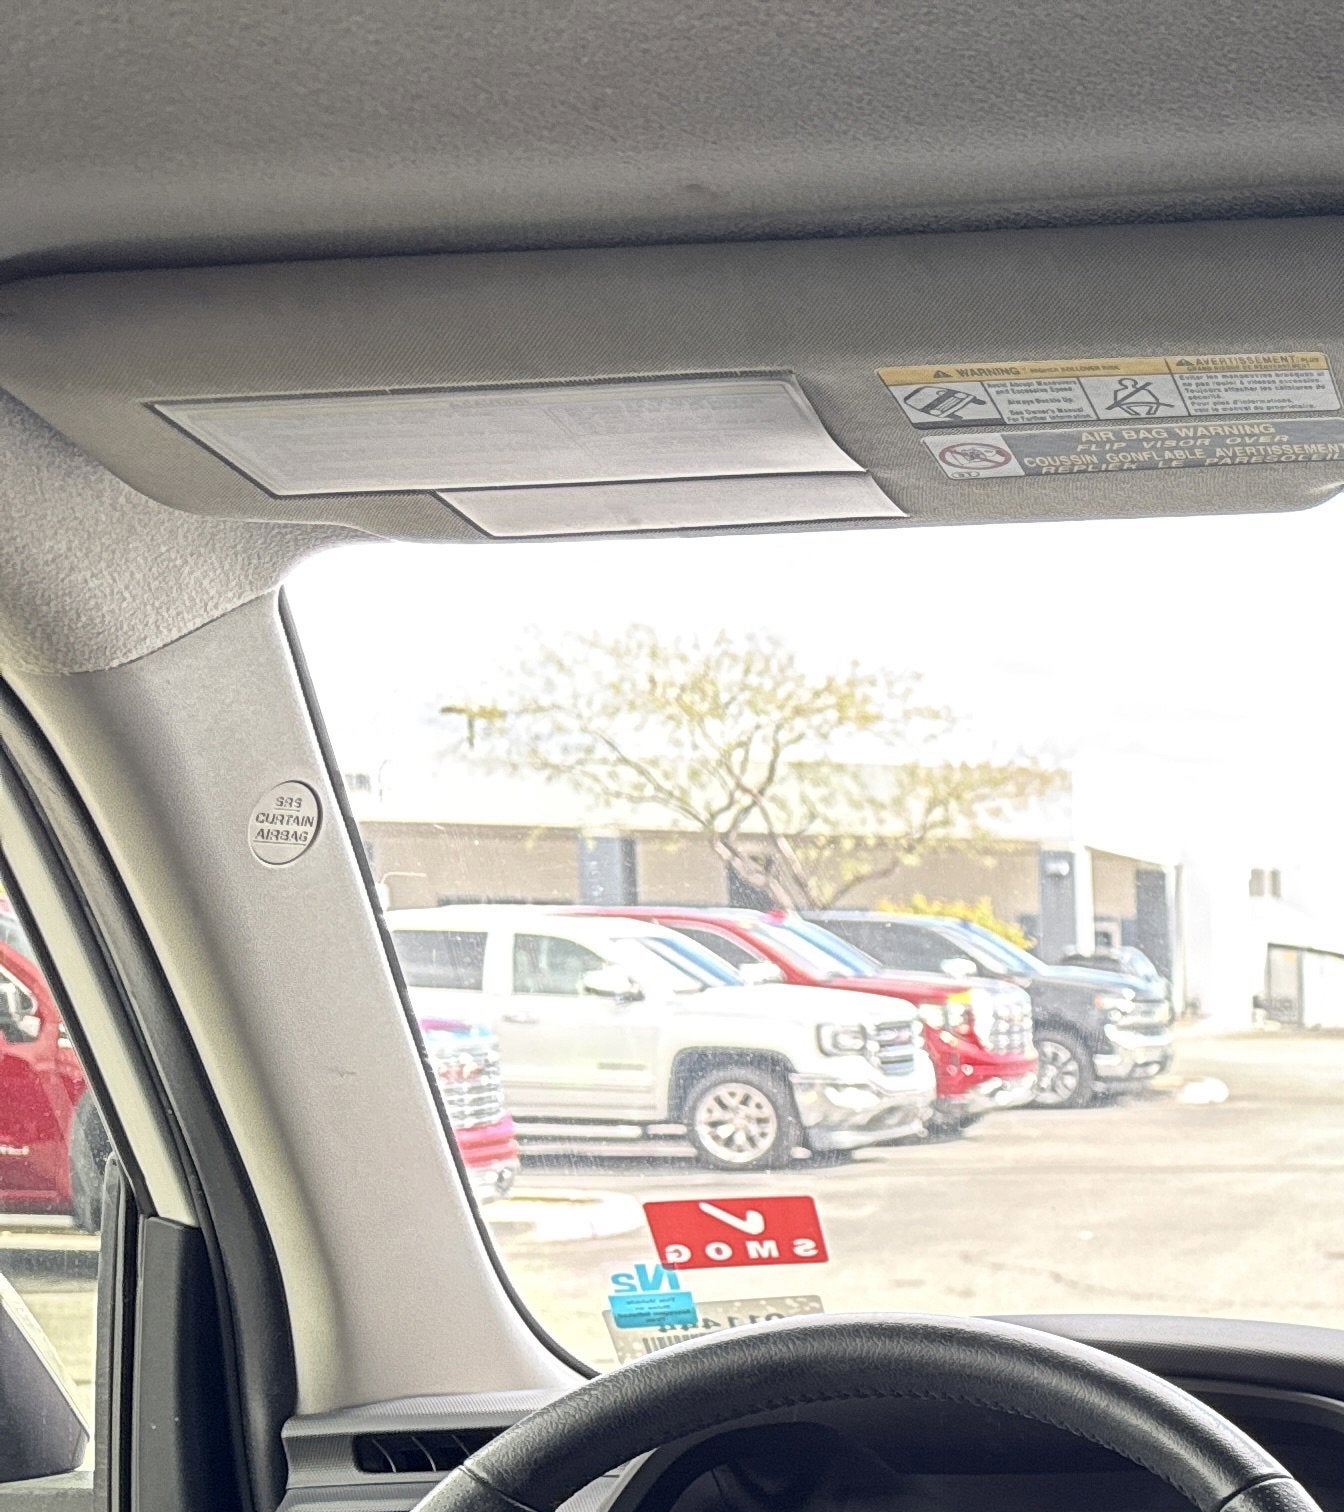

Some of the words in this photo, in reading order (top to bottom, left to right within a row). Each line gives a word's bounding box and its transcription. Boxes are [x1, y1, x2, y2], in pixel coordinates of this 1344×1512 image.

[1081, 431, 1117, 443] AIR
[1122, 428, 1167, 440] BAG
[1175, 423, 1276, 438] WARNING
[1076, 441, 1127, 451] FLIP
[1142, 437, 1212, 448] VISOR
[1226, 434, 1289, 444] OVER
[1024, 453, 1098, 468] COUSSIN
[1106, 448, 1205, 463] GONFLABLE
[1158, 460, 1186, 469] LE
[255, 812, 314, 828] CURTAIN
[254, 828, 309, 842] AIRBAG
